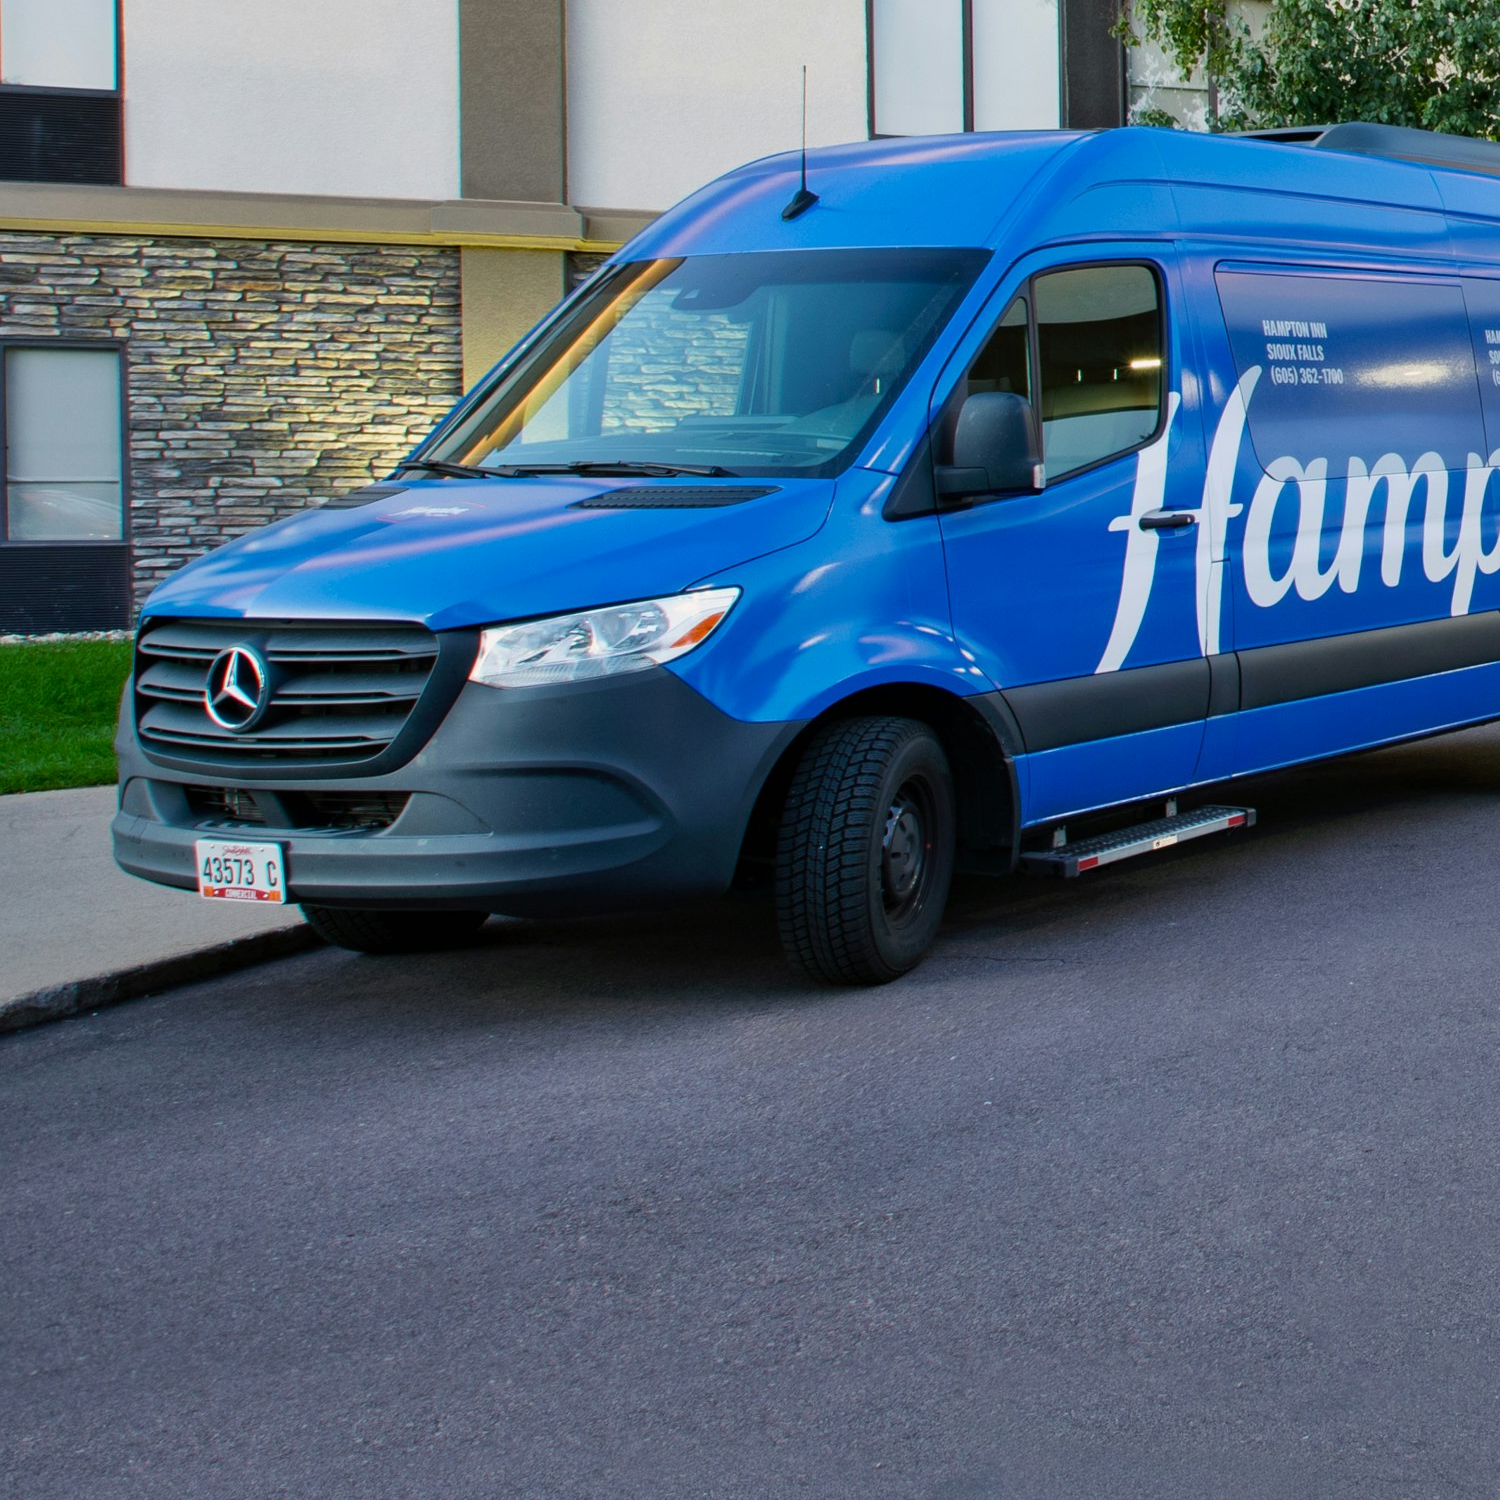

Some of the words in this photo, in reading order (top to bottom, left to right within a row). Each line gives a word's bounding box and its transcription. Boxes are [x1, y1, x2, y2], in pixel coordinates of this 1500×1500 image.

[1262, 319, 1310, 338] HAMPTON
[1309, 322, 1328, 338] INN
[1266, 343, 1296, 360] SIOUX
[1296, 345, 1325, 361] FALLS
[1271, 365, 1298, 386] (605)
[1299, 368, 1344, 384] 362-1700
[203, 856, 255, 886] 43573
[266, 860, 278, 887] C
